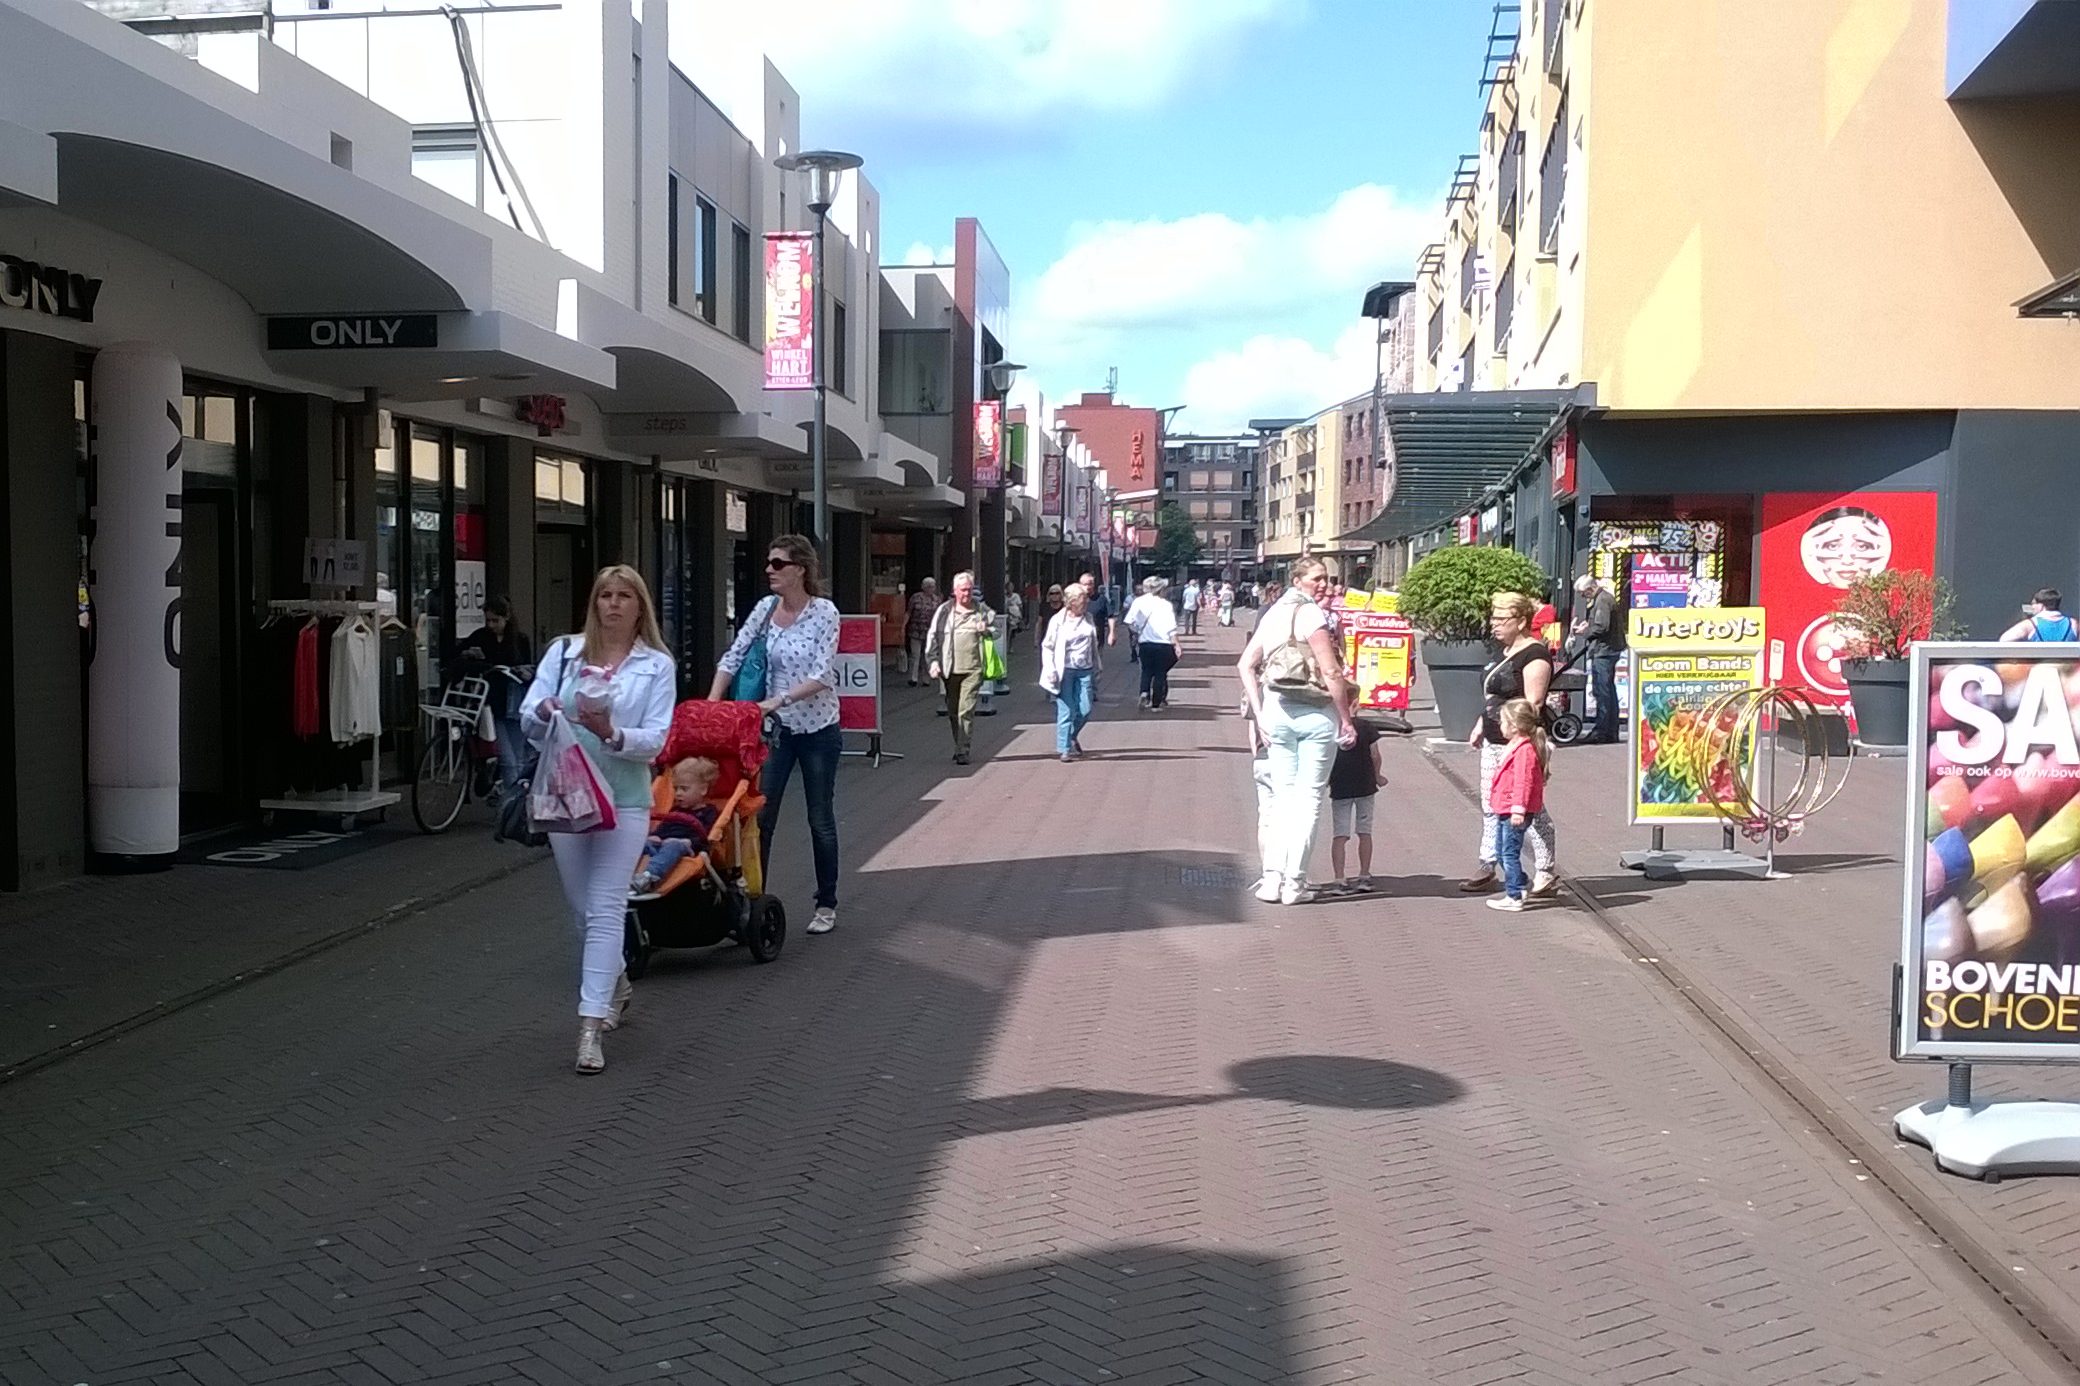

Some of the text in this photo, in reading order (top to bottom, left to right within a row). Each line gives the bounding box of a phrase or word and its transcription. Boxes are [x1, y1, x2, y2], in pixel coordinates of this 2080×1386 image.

[0, 254, 102, 323] ONLY
[311, 319, 402, 346] ONLY
[772, 360, 808, 376] HART
[1131, 429, 1144, 481] HEMA
[1661, 529, 1693, 545] 75%
[1641, 553, 1692, 567] ACTIE
[1646, 574, 1677, 584] HALVE
[1369, 618, 1410, 629] Kruidvat
[1635, 616, 1760, 642] Intertoys
[1641, 655, 1752, 672] Loom Bands
[1644, 681, 1748, 695] de enige echte!
[1936, 663, 2080, 765] SA
[1936, 766, 1964, 776] sale
[1967, 766, 1991, 776] ook
[1994, 767, 2012, 779] op
[1923, 991, 2080, 1032] SCHOE
